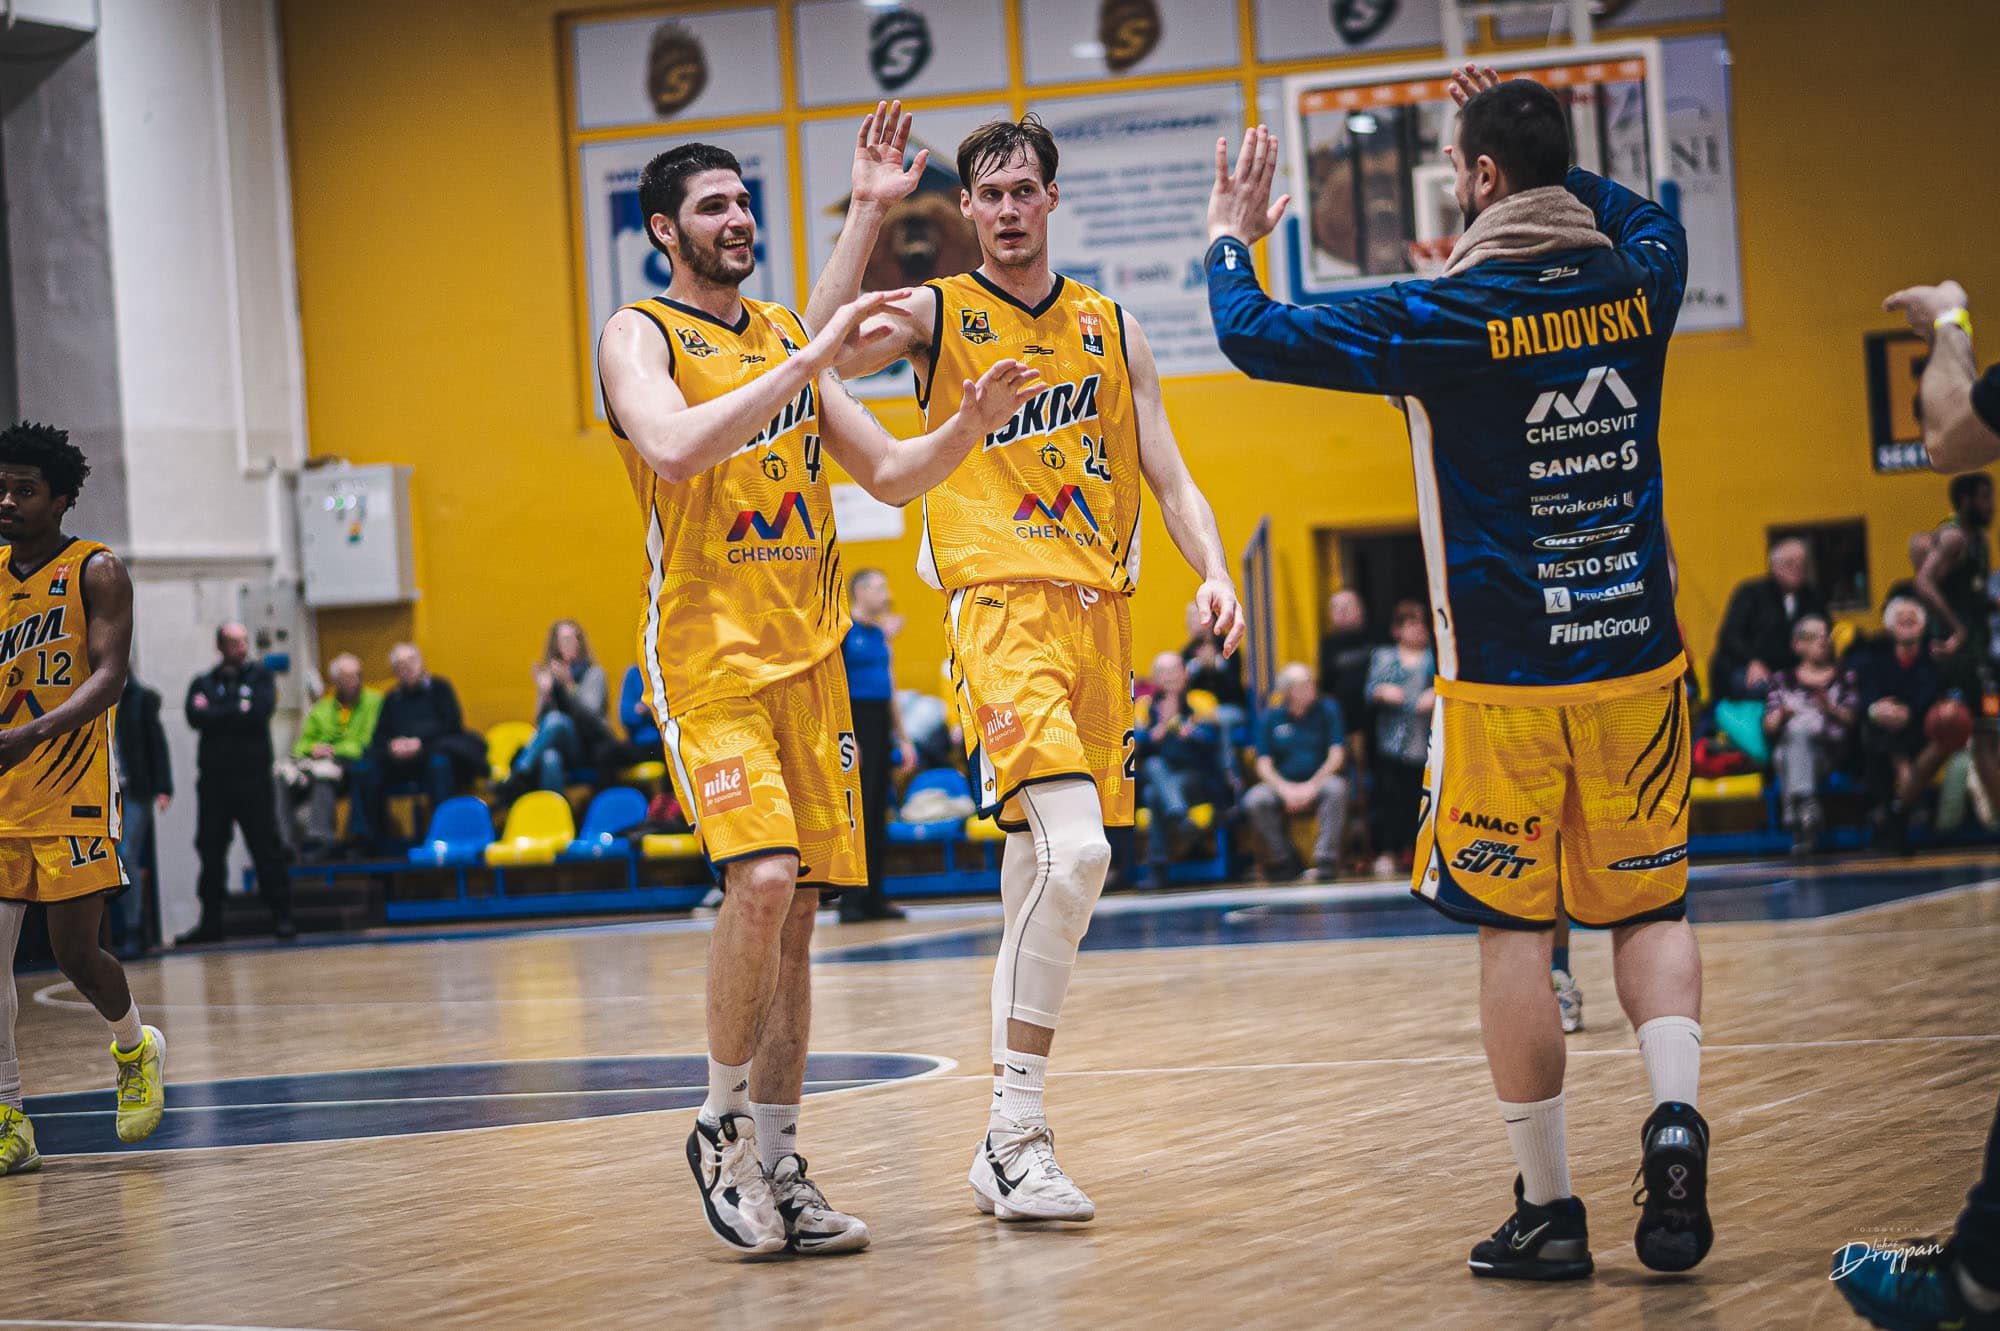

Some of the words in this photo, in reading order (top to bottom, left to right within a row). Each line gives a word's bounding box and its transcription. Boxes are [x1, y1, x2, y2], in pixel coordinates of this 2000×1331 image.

[1487, 287, 1653, 360] BALDOVSKÝ
[1526, 413, 1637, 445] CHEMOSVIT
[803, 434, 822, 485] 4
[1529, 451, 1618, 480] SANAC
[1530, 494, 1618, 517] Tervakoski
[727, 546, 817, 565] CHEMOSVIT
[1538, 557, 1600, 580] MESTO
[1549, 616, 1650, 645] FlintGroup
[35, 650, 72, 687] 12
[1450, 806, 1519, 835] SANAC
